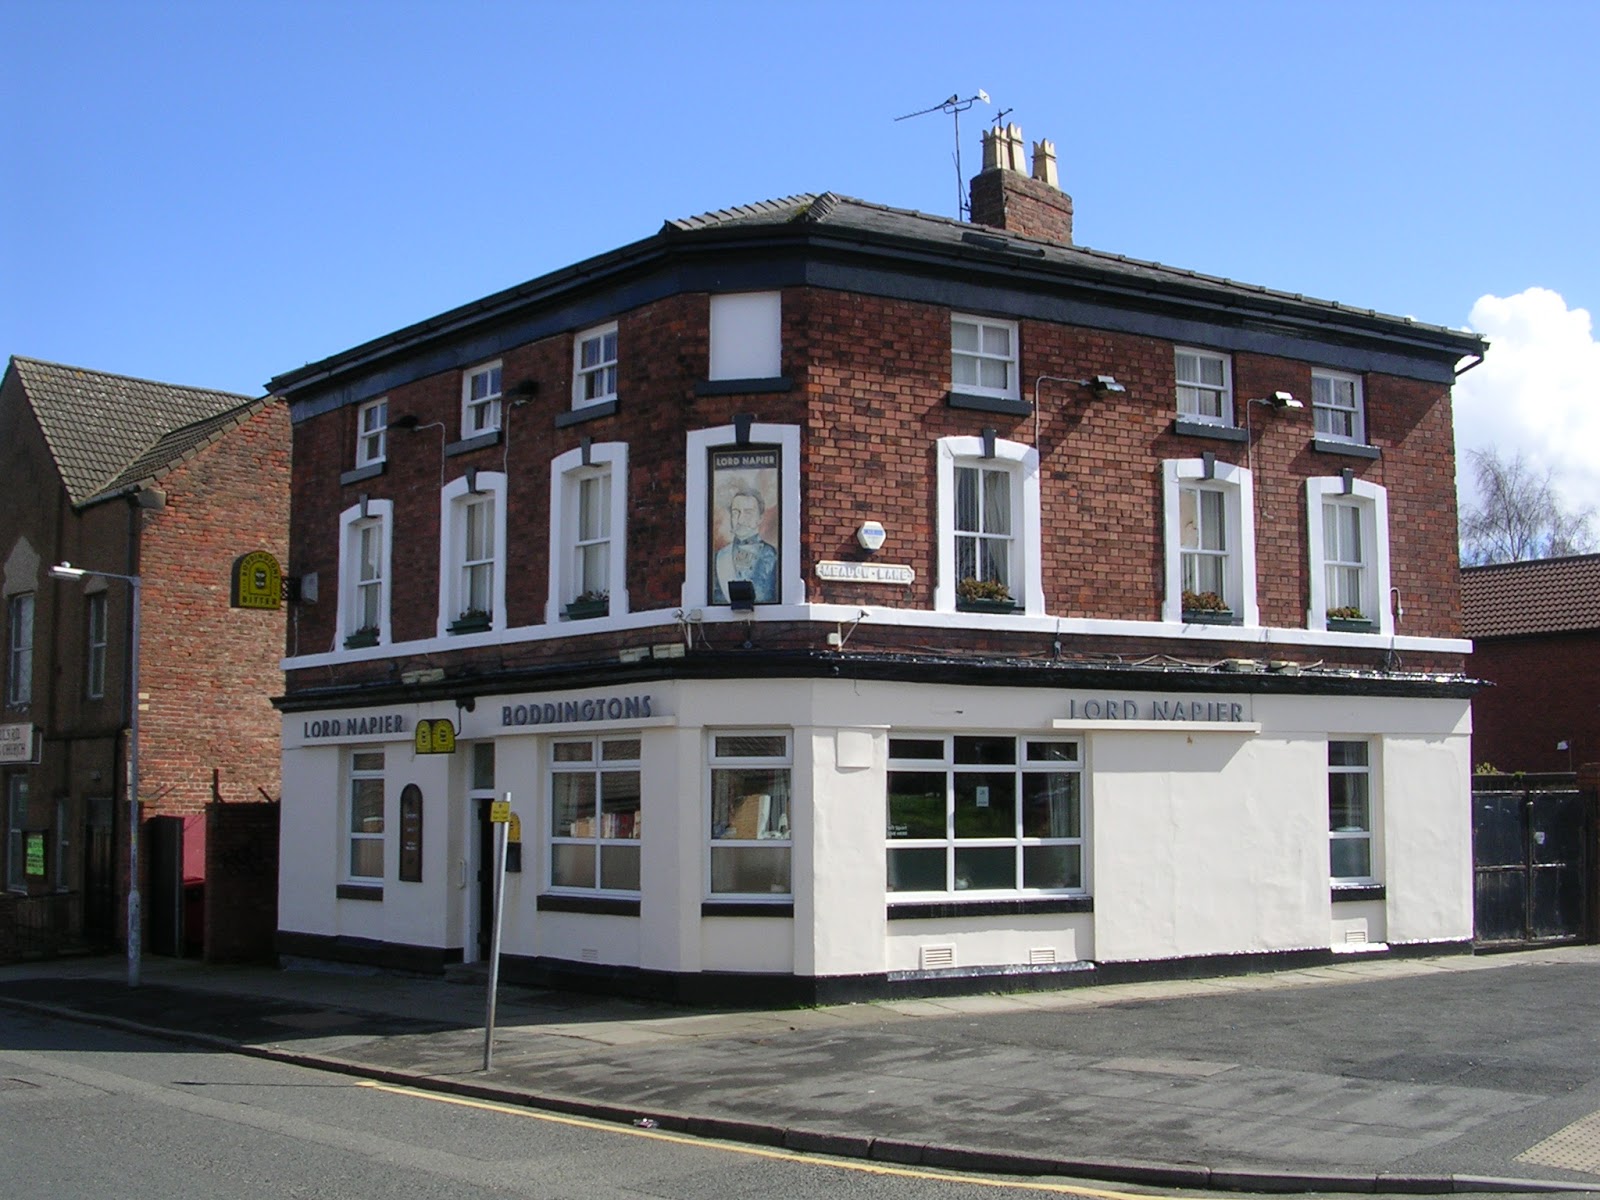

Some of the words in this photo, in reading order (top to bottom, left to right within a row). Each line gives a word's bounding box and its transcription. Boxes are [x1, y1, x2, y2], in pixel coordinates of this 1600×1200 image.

[716, 457, 740, 466] LORD
[742, 455, 775, 465] NAPIER
[502, 695, 651, 726] BODDINGTONS
[1070, 699, 1138, 720] LORD
[1152, 700, 1243, 722] NAPIER
[304, 720, 341, 738] LORD
[347, 715, 403, 735] NAPIER
